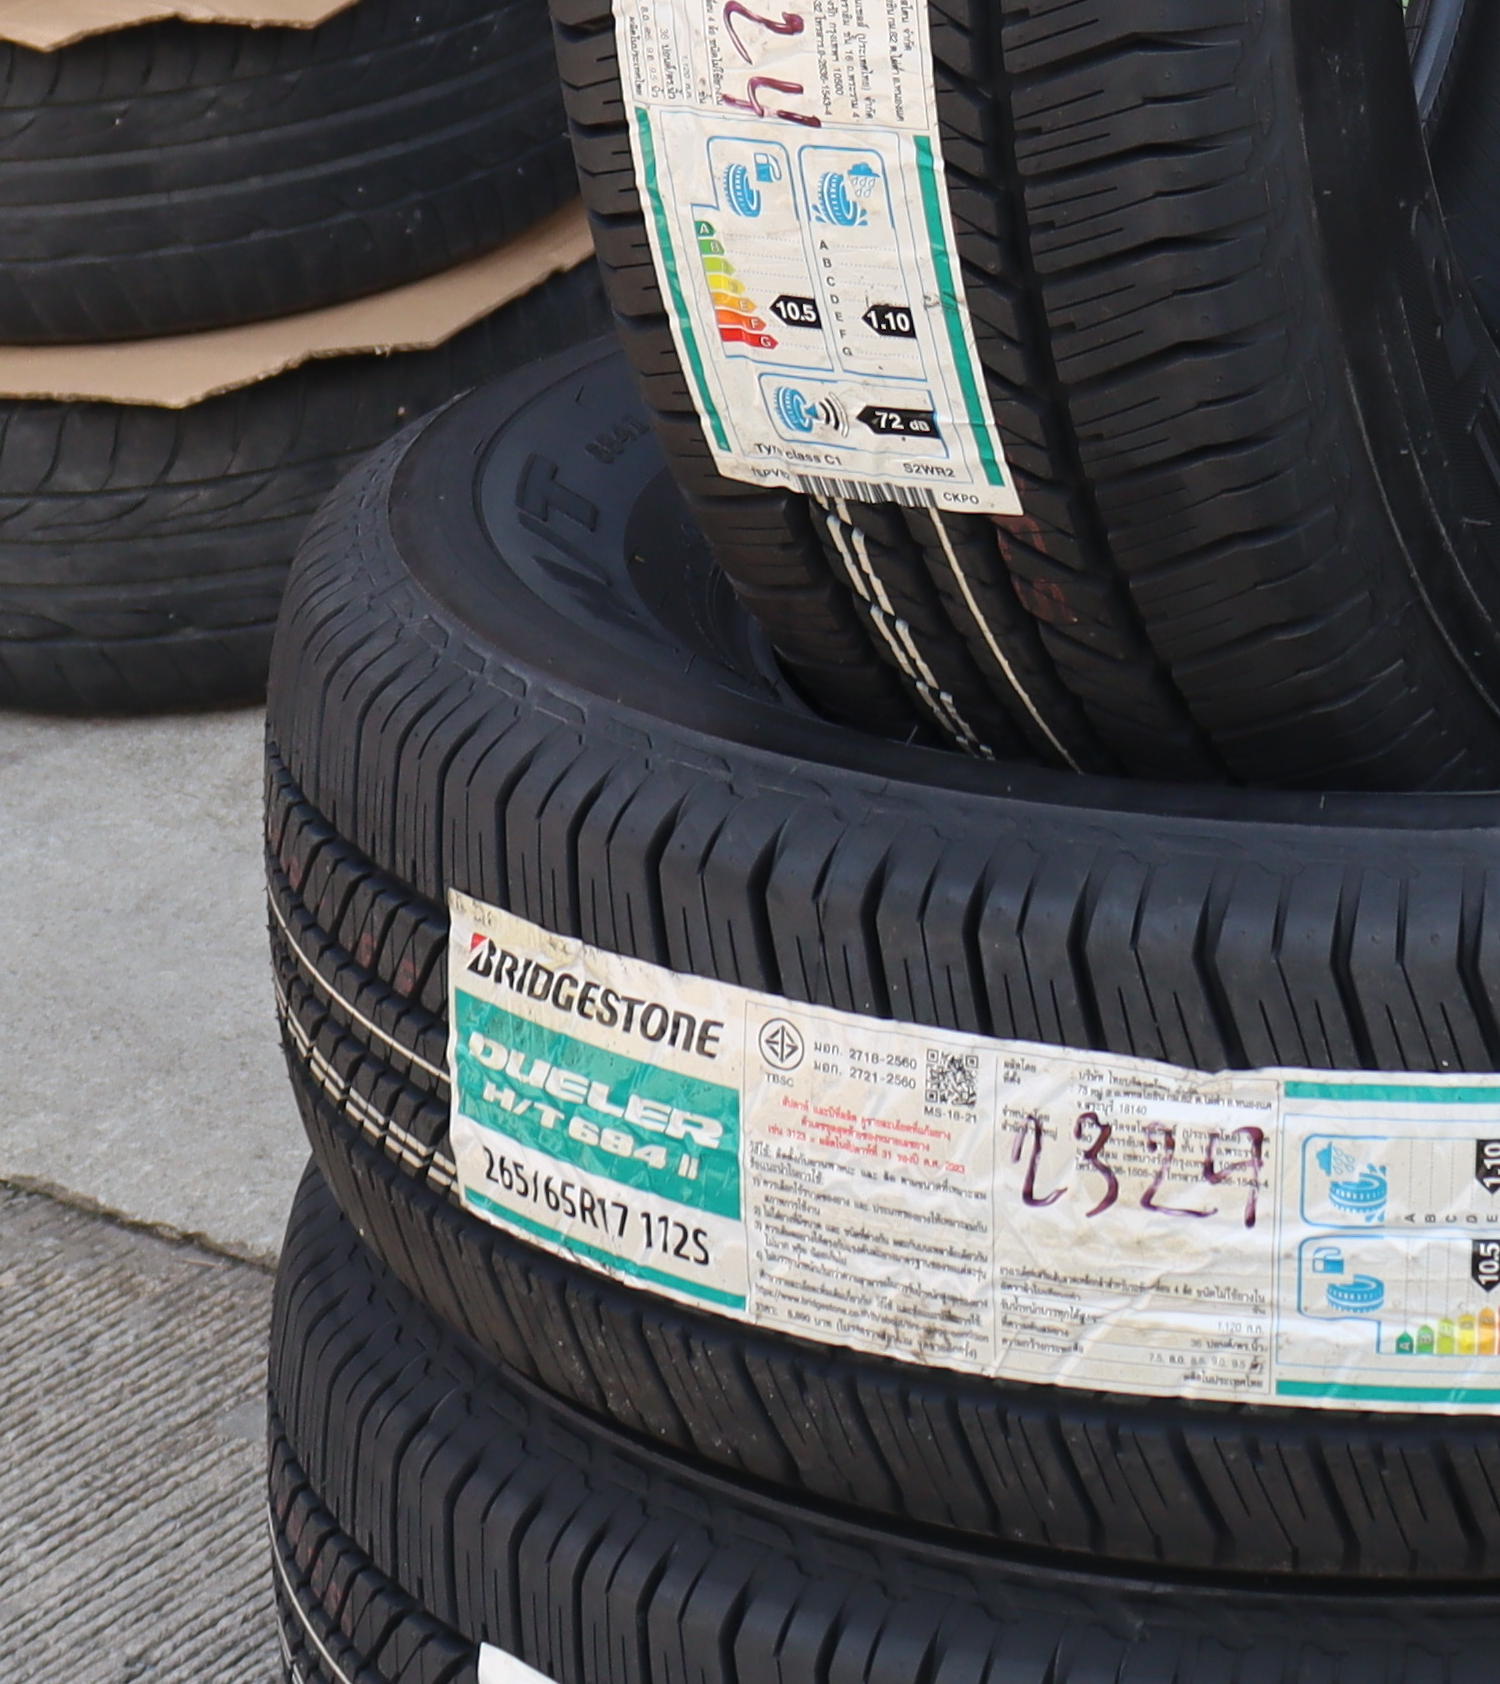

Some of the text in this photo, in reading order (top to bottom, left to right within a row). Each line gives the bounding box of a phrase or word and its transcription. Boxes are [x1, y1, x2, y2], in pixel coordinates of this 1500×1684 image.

[775, 302, 817, 322] 10.5
[867, 311, 910, 332] 1.10
[874, 411, 904, 429] 72
[785, 450, 821, 465] class
[824, 453, 842, 465] C1
[465, 932, 725, 1061] BRIDGESTONE
[813, 1041, 916, 1069] มอก. 2718-2560
[765, 1072, 793, 1087] TBSC
[813, 1060, 915, 1089] มอก. 2721-2560
[466, 1031, 726, 1150] DUELER
[482, 1080, 566, 1134] H/T
[568, 1117, 667, 1171] 684
[924, 1105, 977, 1122] MS-18-21
[482, 1144, 630, 1240] 265/65R17
[639, 1211, 712, 1268] 112S
[1478, 1242, 1500, 1286] 10.5
